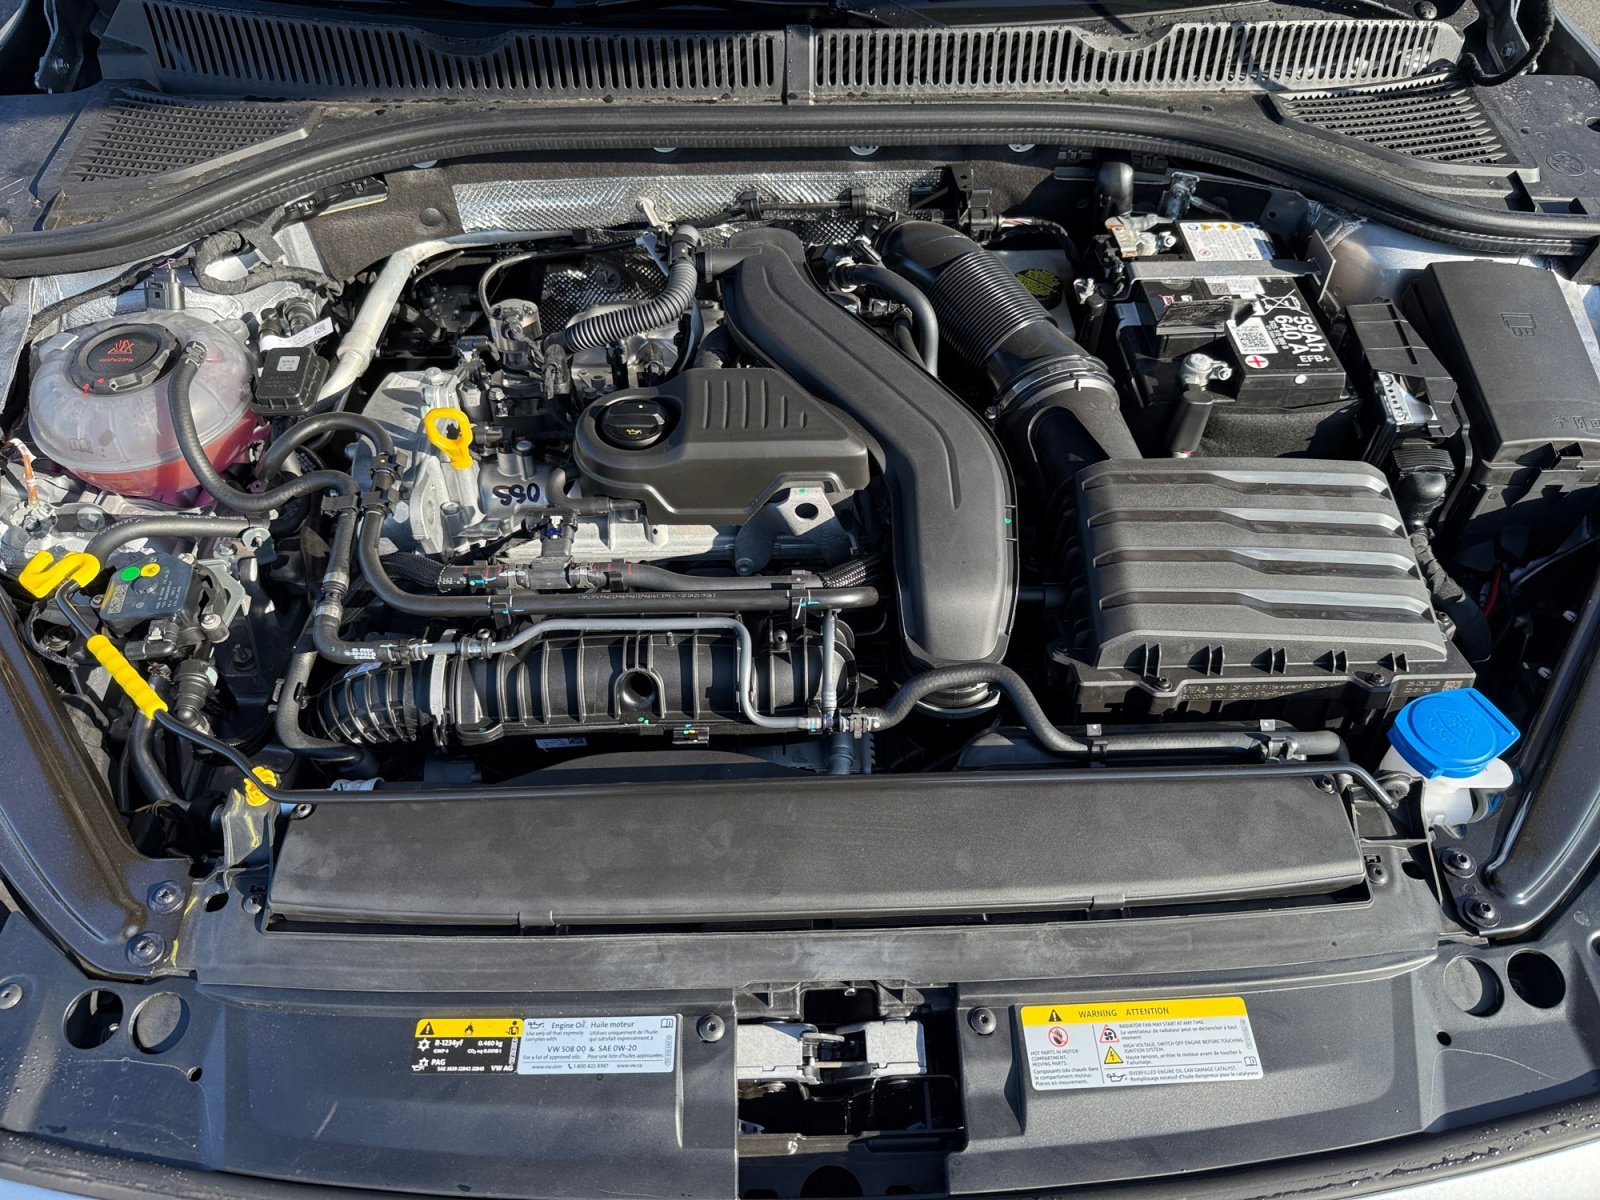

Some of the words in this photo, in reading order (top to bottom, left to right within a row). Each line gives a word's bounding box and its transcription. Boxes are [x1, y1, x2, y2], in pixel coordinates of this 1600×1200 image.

[1274, 315, 1302, 340] 640
[1288, 343, 1310, 355] A
[1294, 316, 1326, 352] 59Ah
[1299, 354, 1332, 363] EFB+
[1078, 1009, 1117, 1018] WARNING
[1126, 1007, 1169, 1016] ATTENTION
[552, 1022, 574, 1030] Engine
[434, 1039, 464, 1048] R-1234yf
[496, 1040, 503, 1048] kg
